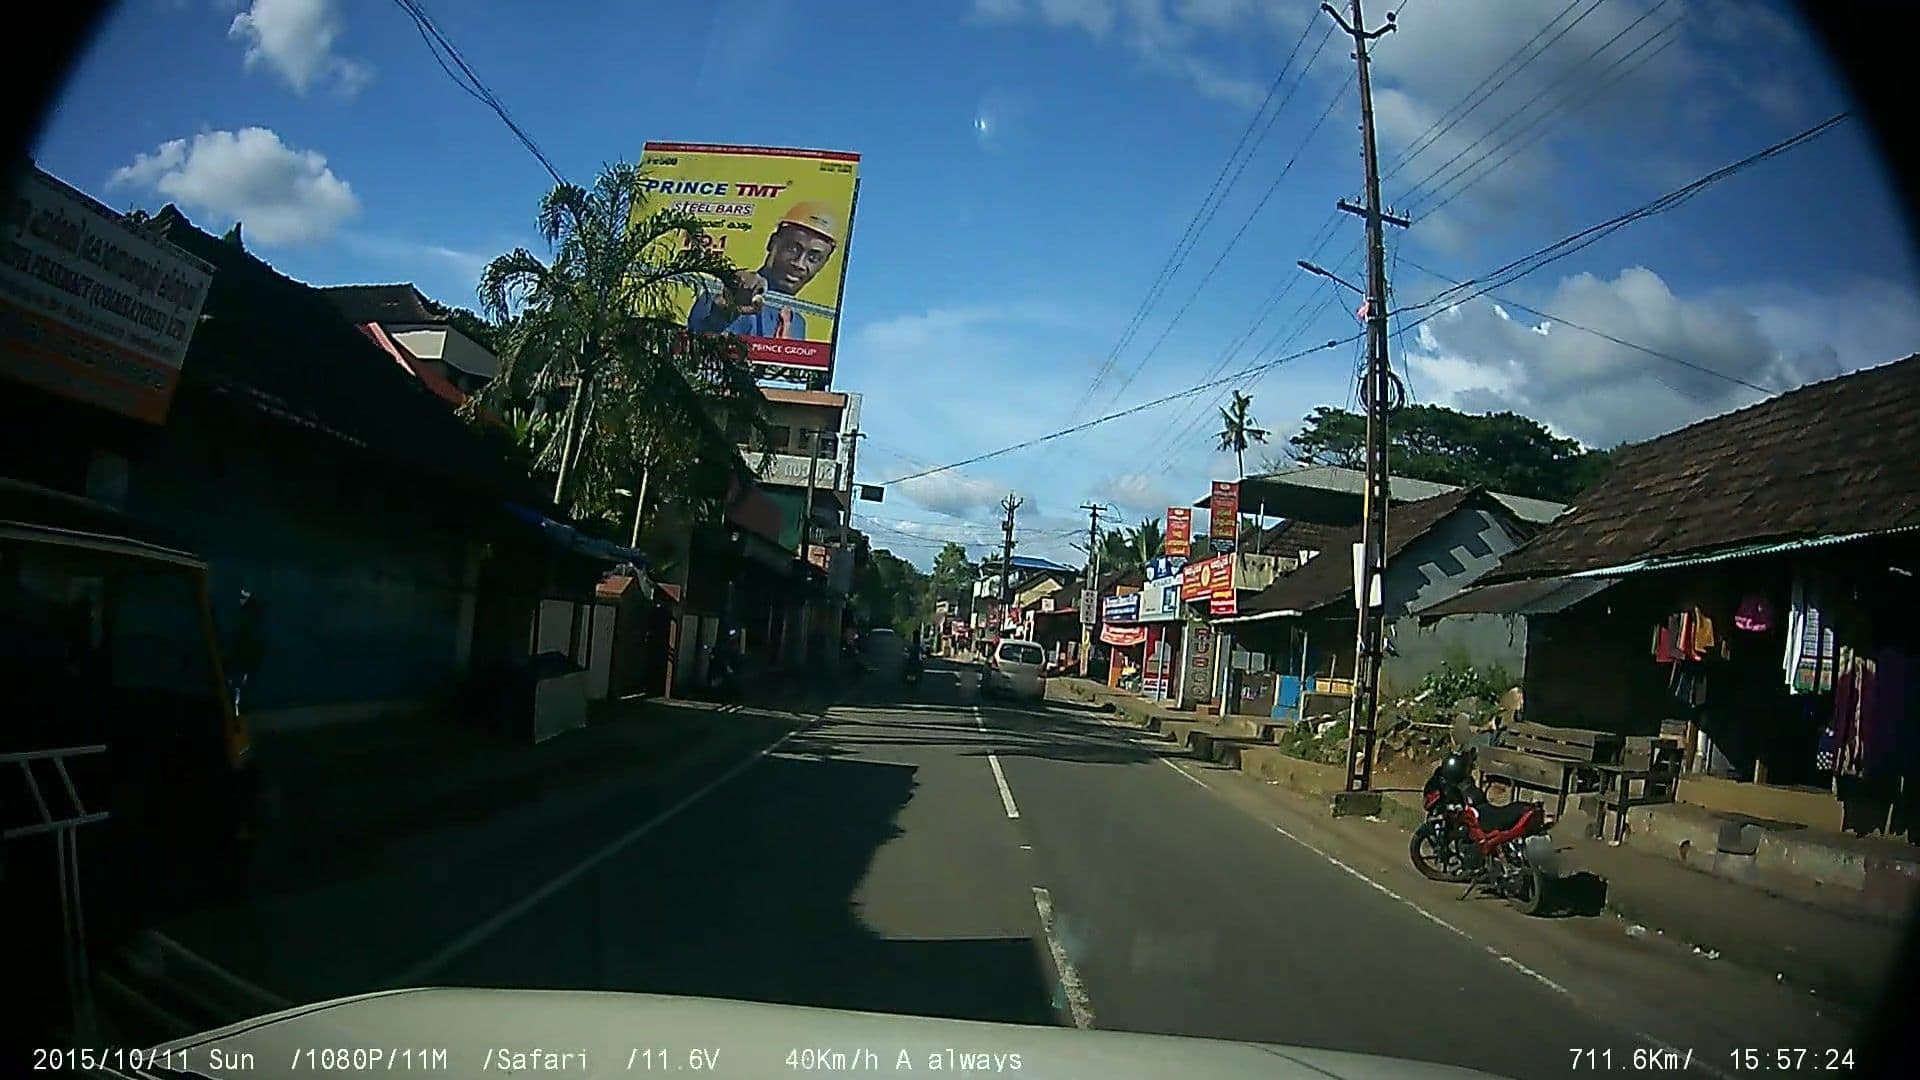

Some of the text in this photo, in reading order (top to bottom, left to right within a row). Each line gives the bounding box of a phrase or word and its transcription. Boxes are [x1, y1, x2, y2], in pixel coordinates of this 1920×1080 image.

[645, 179, 786, 198] PRINCE TMT
[673, 201, 752, 216] STEEL BARS
[751, 343, 817, 356] PRINCE GROUP
